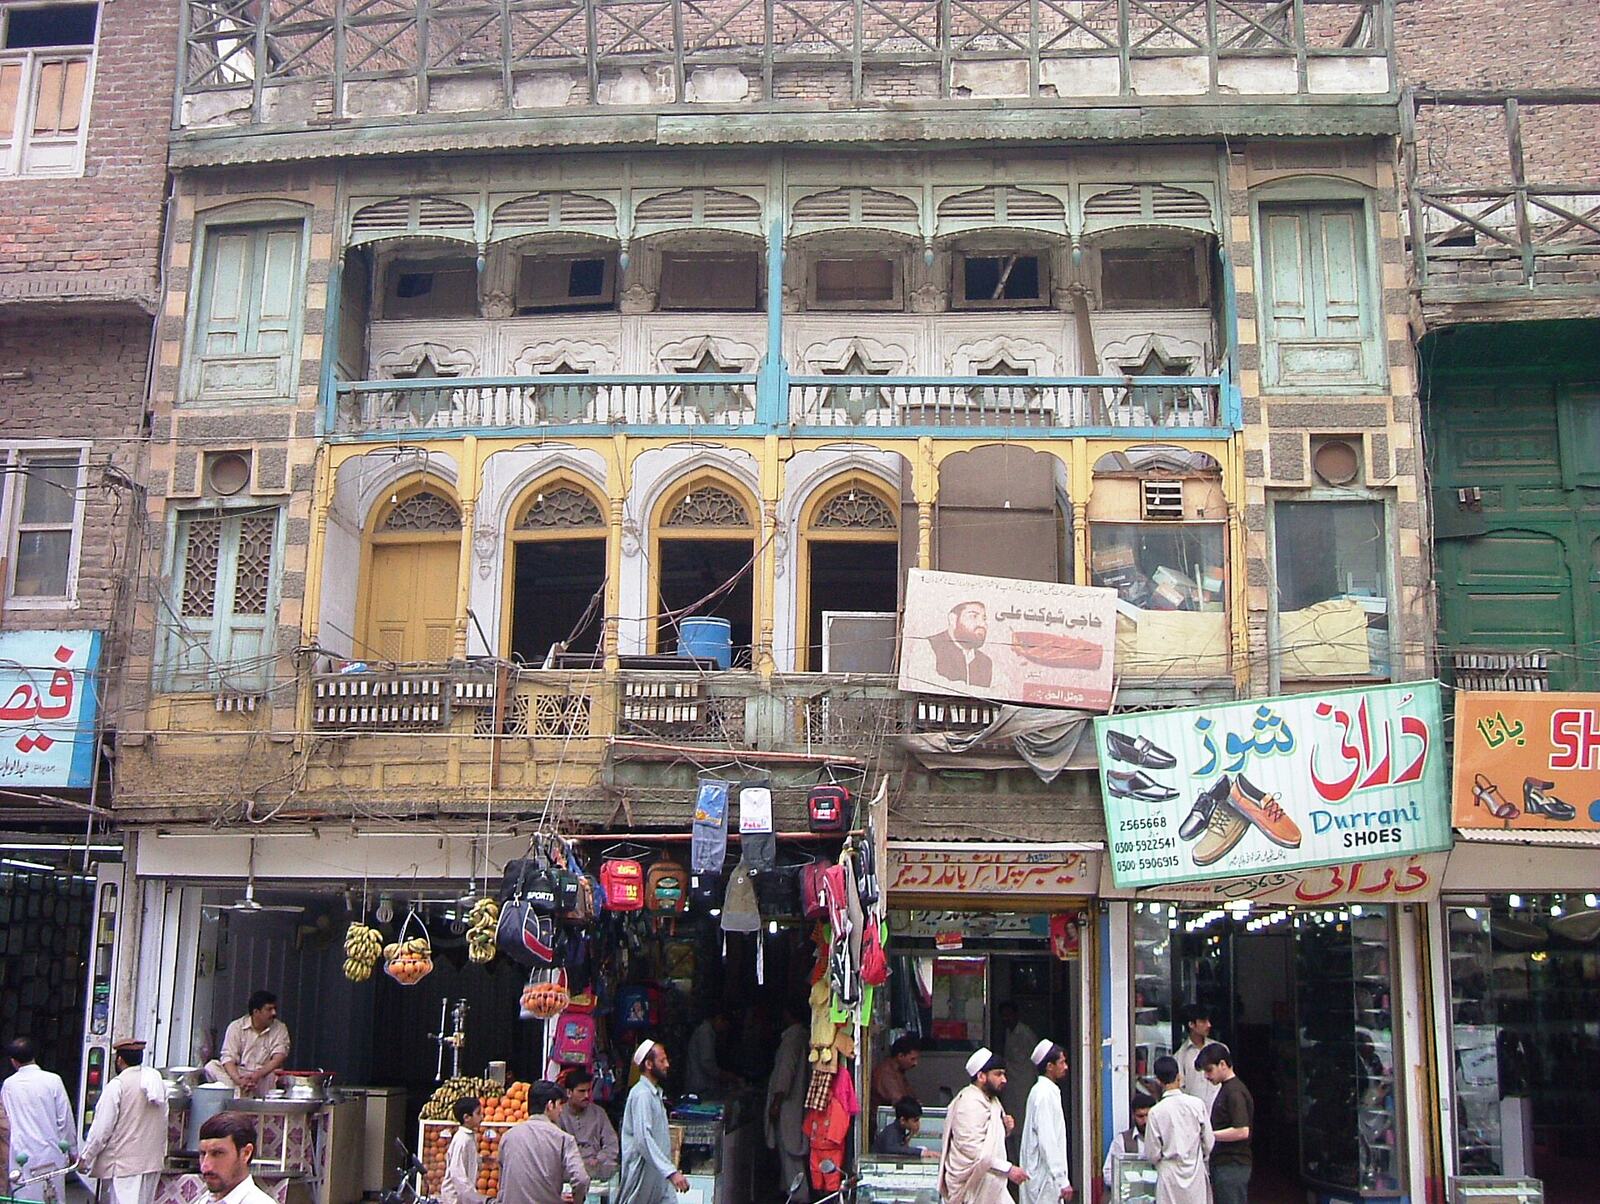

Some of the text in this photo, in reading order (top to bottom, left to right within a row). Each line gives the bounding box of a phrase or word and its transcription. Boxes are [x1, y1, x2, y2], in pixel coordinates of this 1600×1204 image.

[995, 605, 1102, 630] حاجی شوکت علی
[1191, 705, 1296, 775] شوز
[1120, 817, 1167, 831] 2565668
[1309, 800, 1420, 834] Durrani
[1136, 837, 1175, 852] 5922541
[1343, 828, 1401, 848] SHOES
[1116, 855, 1179, 871] 0300 5906915
[527, 890, 554, 901] SPORTS
